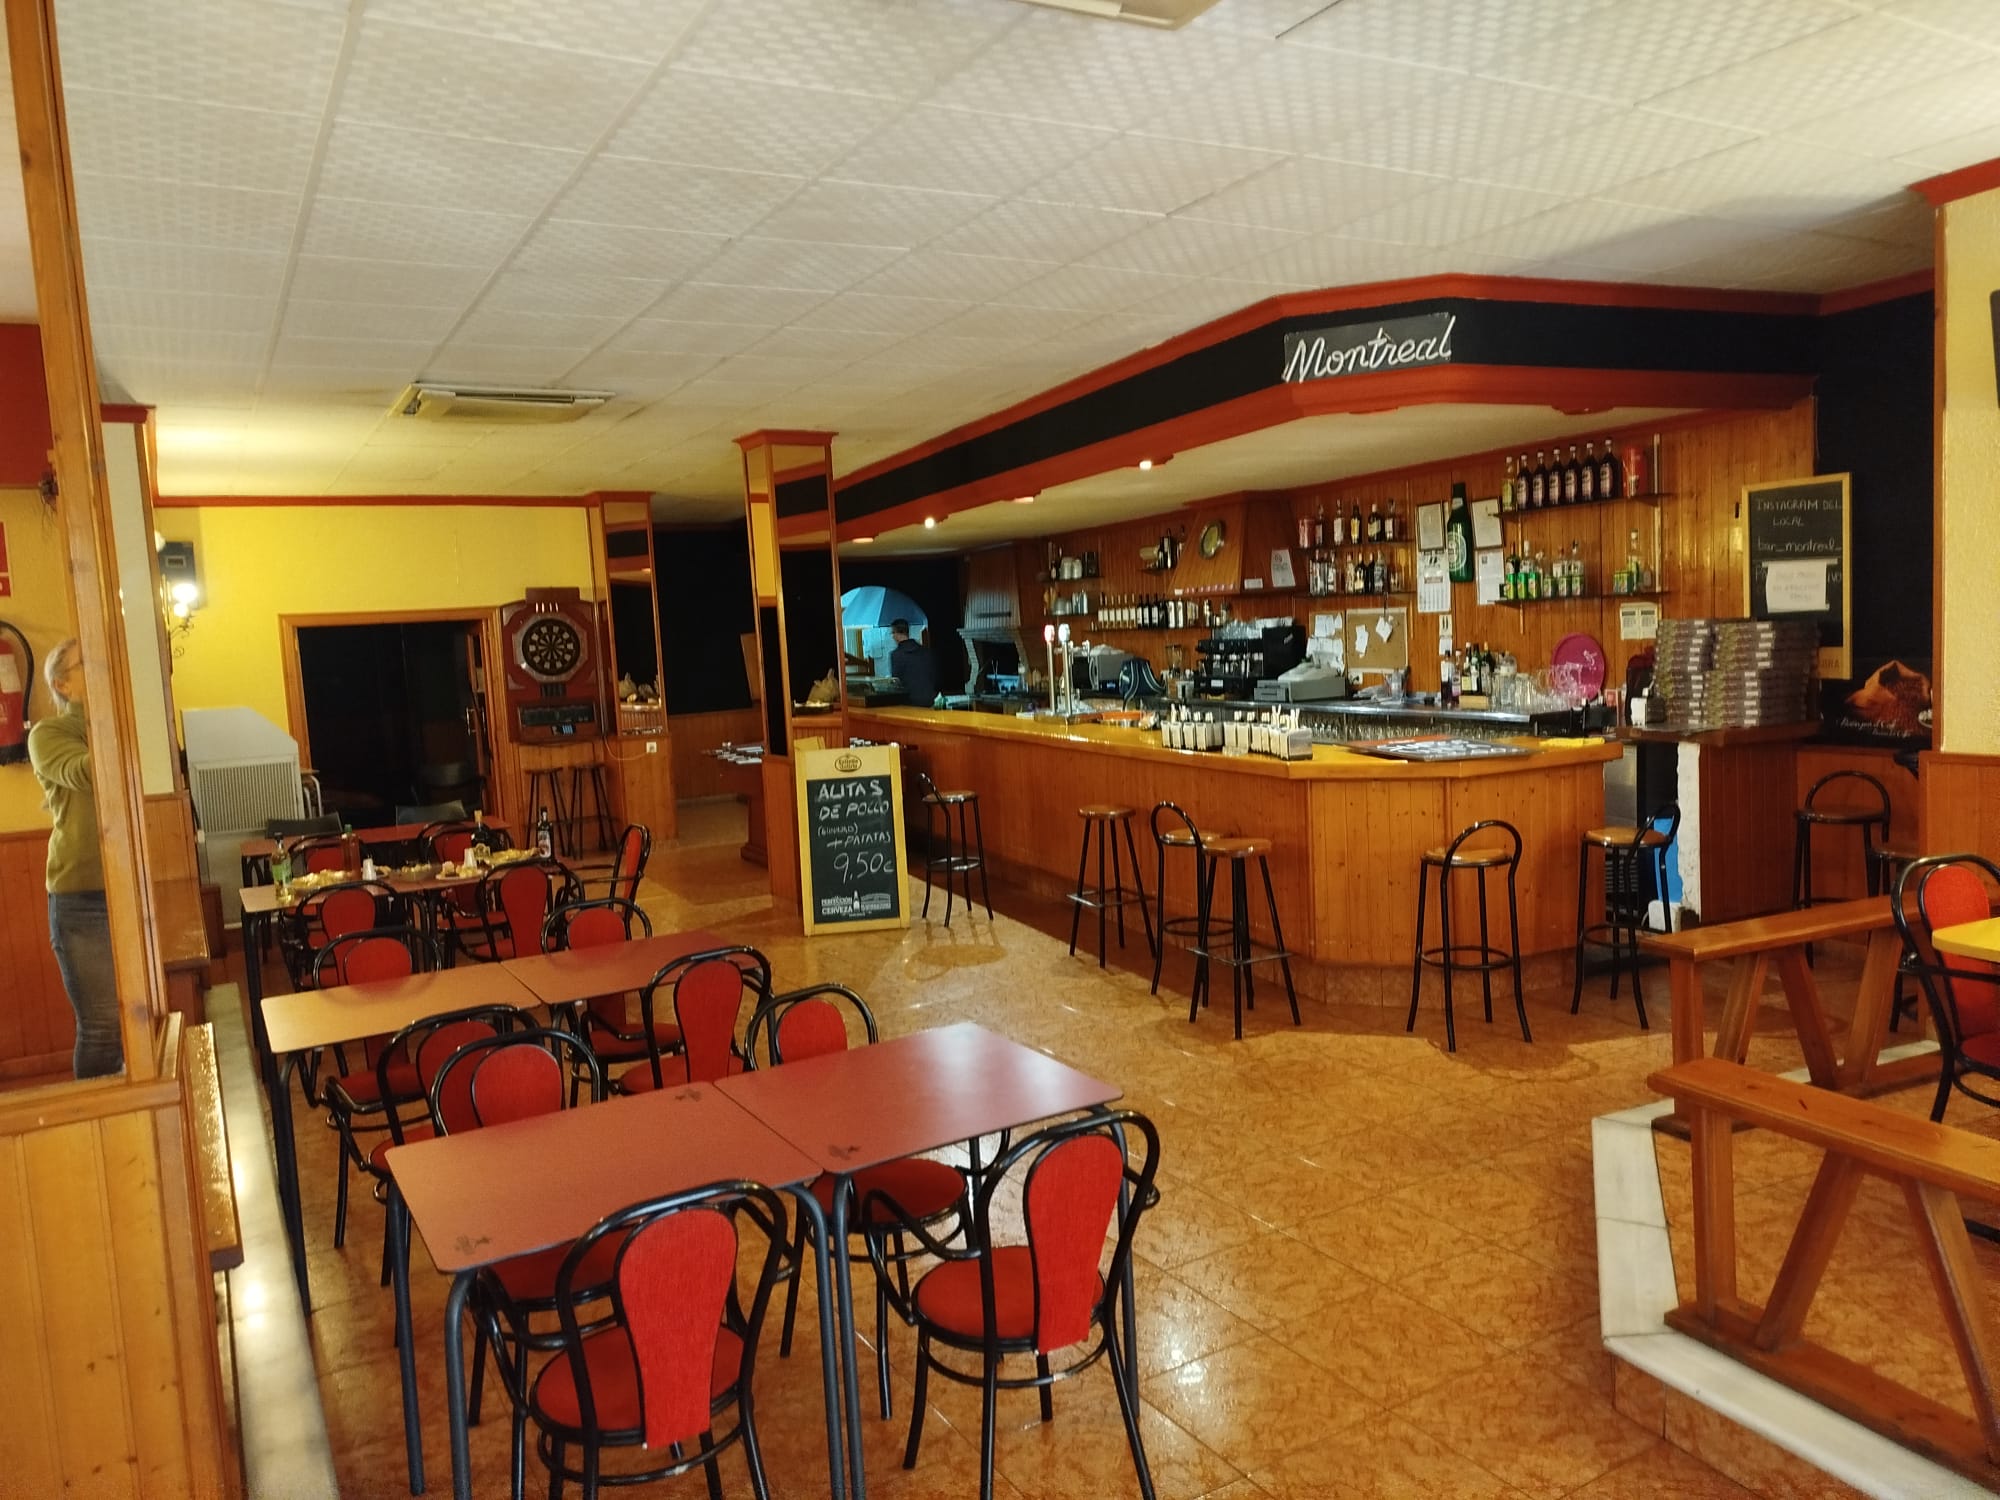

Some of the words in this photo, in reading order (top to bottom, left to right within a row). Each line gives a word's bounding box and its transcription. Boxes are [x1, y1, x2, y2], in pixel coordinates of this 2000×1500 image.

[1282, 315, 1456, 384] Montreal
[1756, 498, 1818, 511] INSTAGRAM
[817, 779, 884, 802] ALITAS
[819, 803, 841, 821] DE
[846, 800, 889, 818] POLLO
[844, 831, 891, 848] PATATAS
[821, 906, 853, 915] CERVEZA
